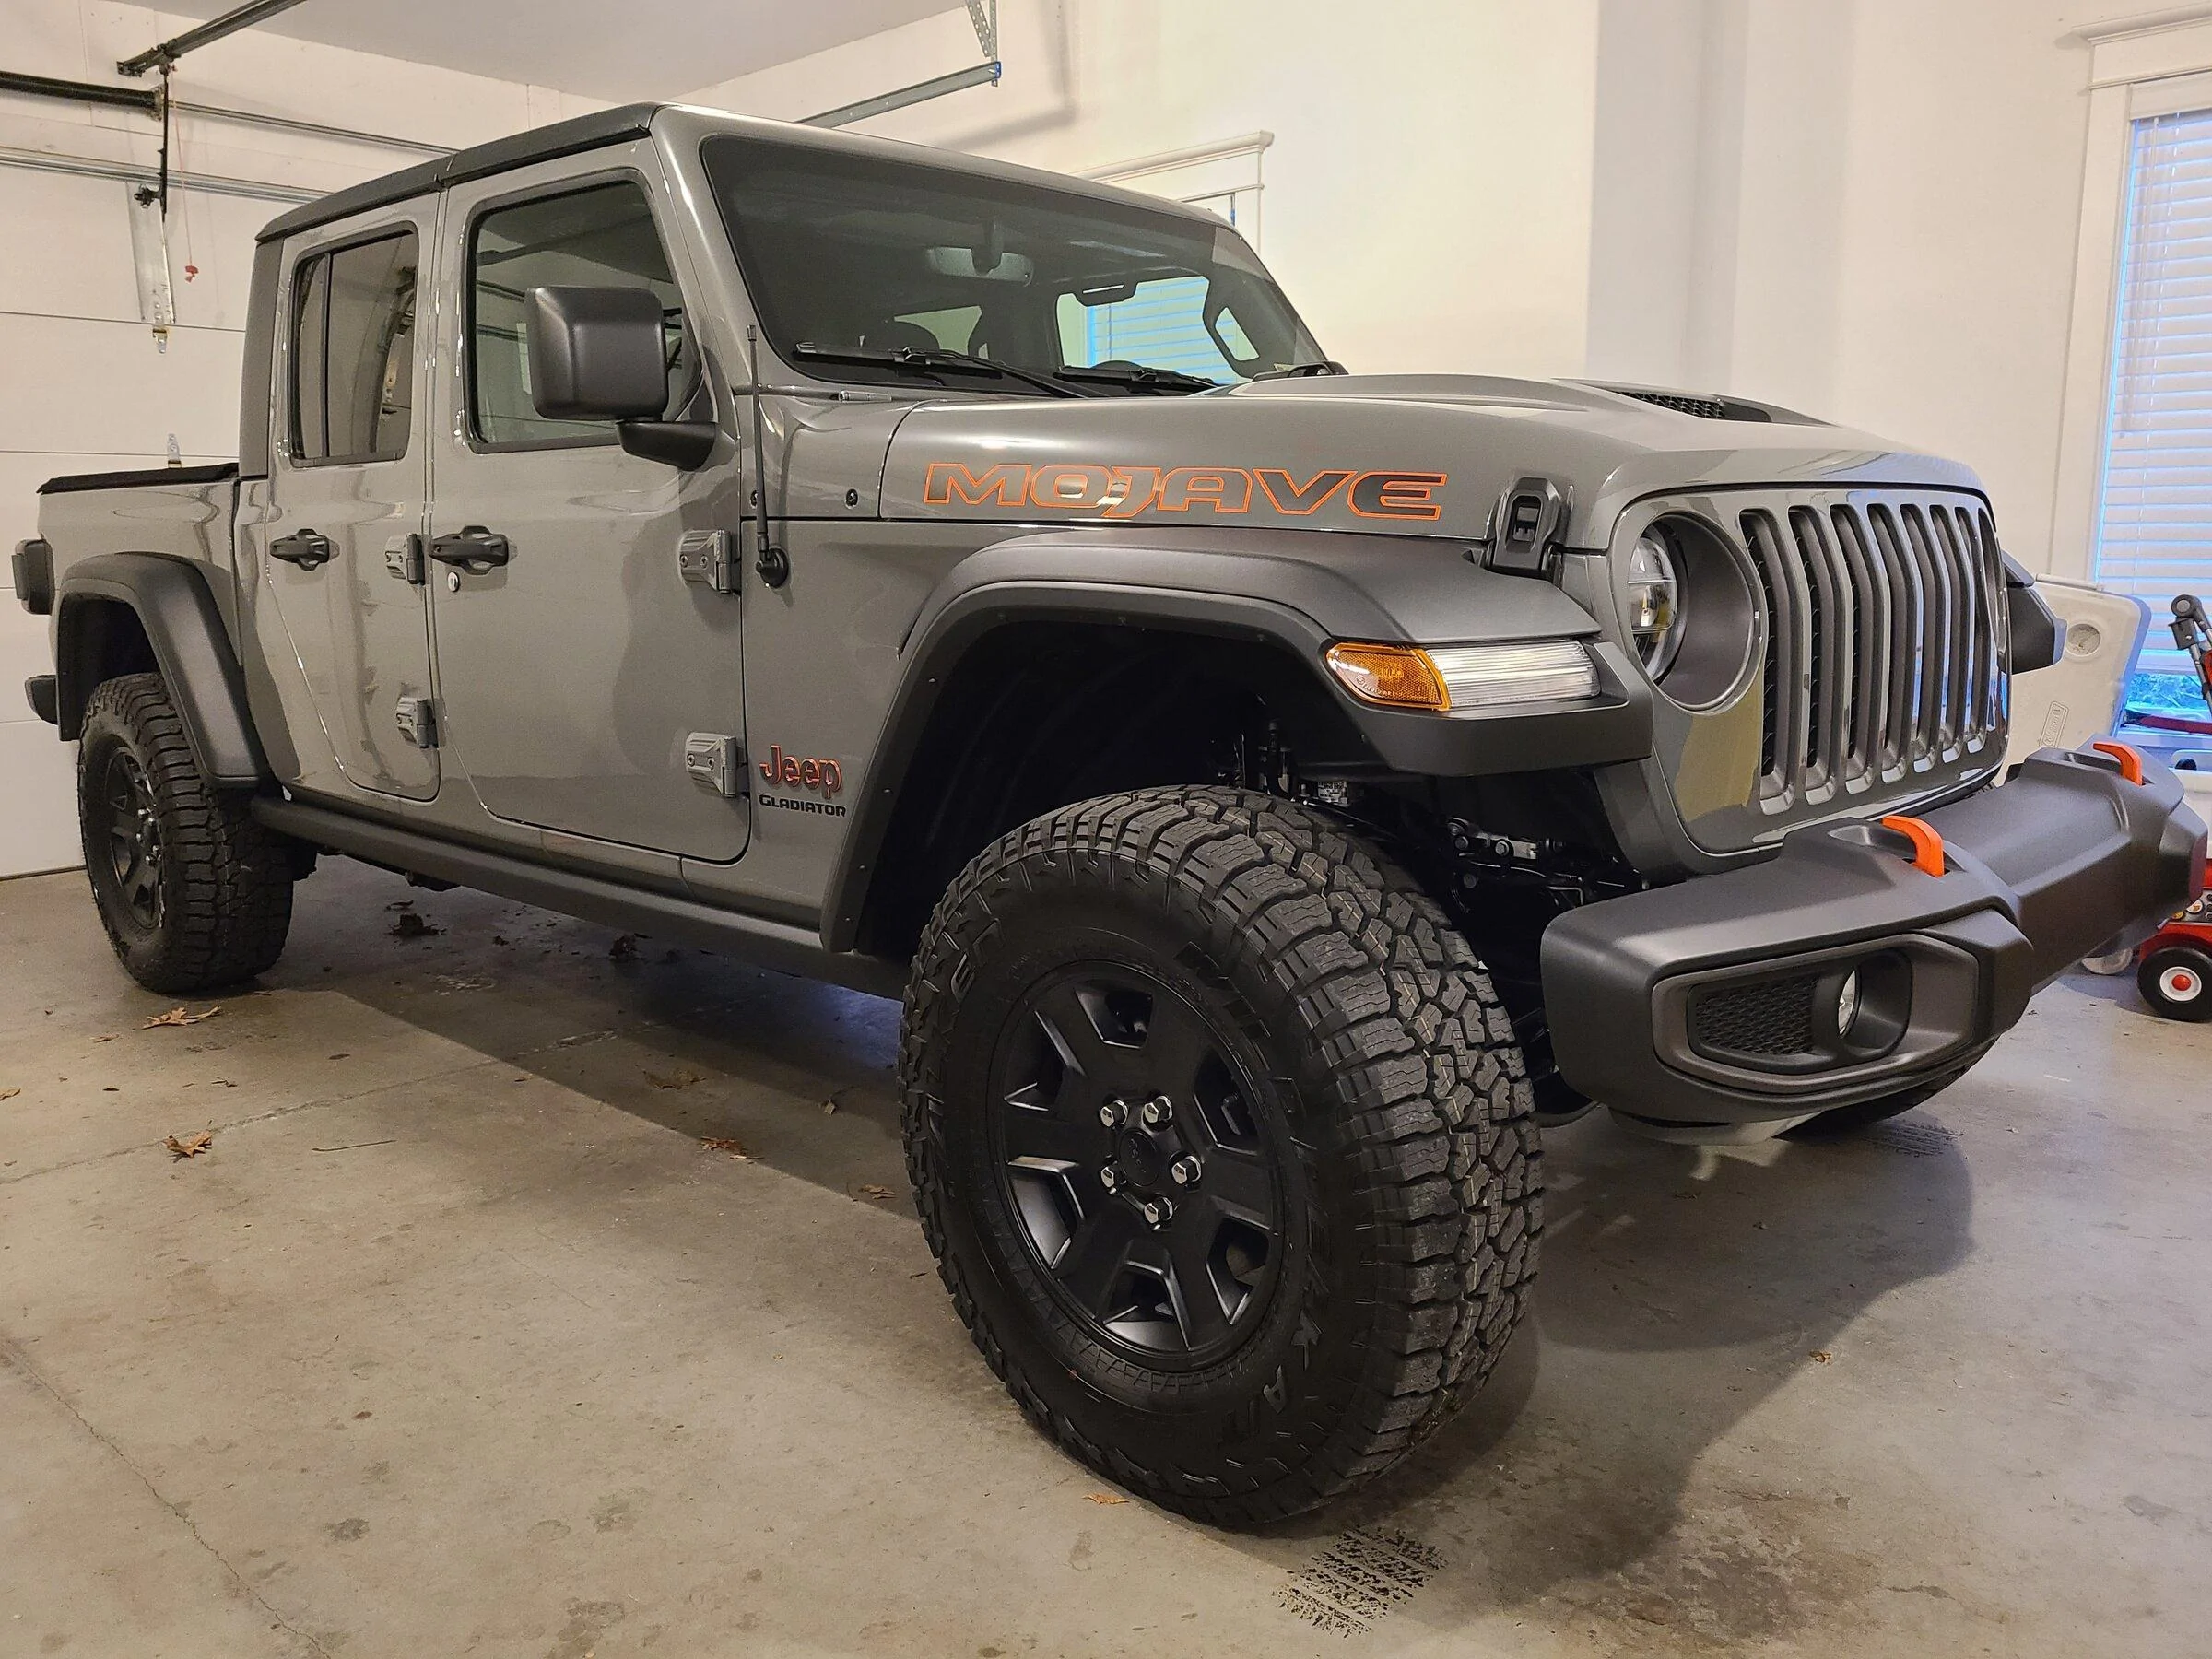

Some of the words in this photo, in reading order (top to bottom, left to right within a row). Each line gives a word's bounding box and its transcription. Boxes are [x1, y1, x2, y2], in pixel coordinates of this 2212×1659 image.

[924, 463, 1448, 521] MOJAVE
[759, 744, 842, 800] Jeep
[758, 794, 847, 818] GLADIATOR
